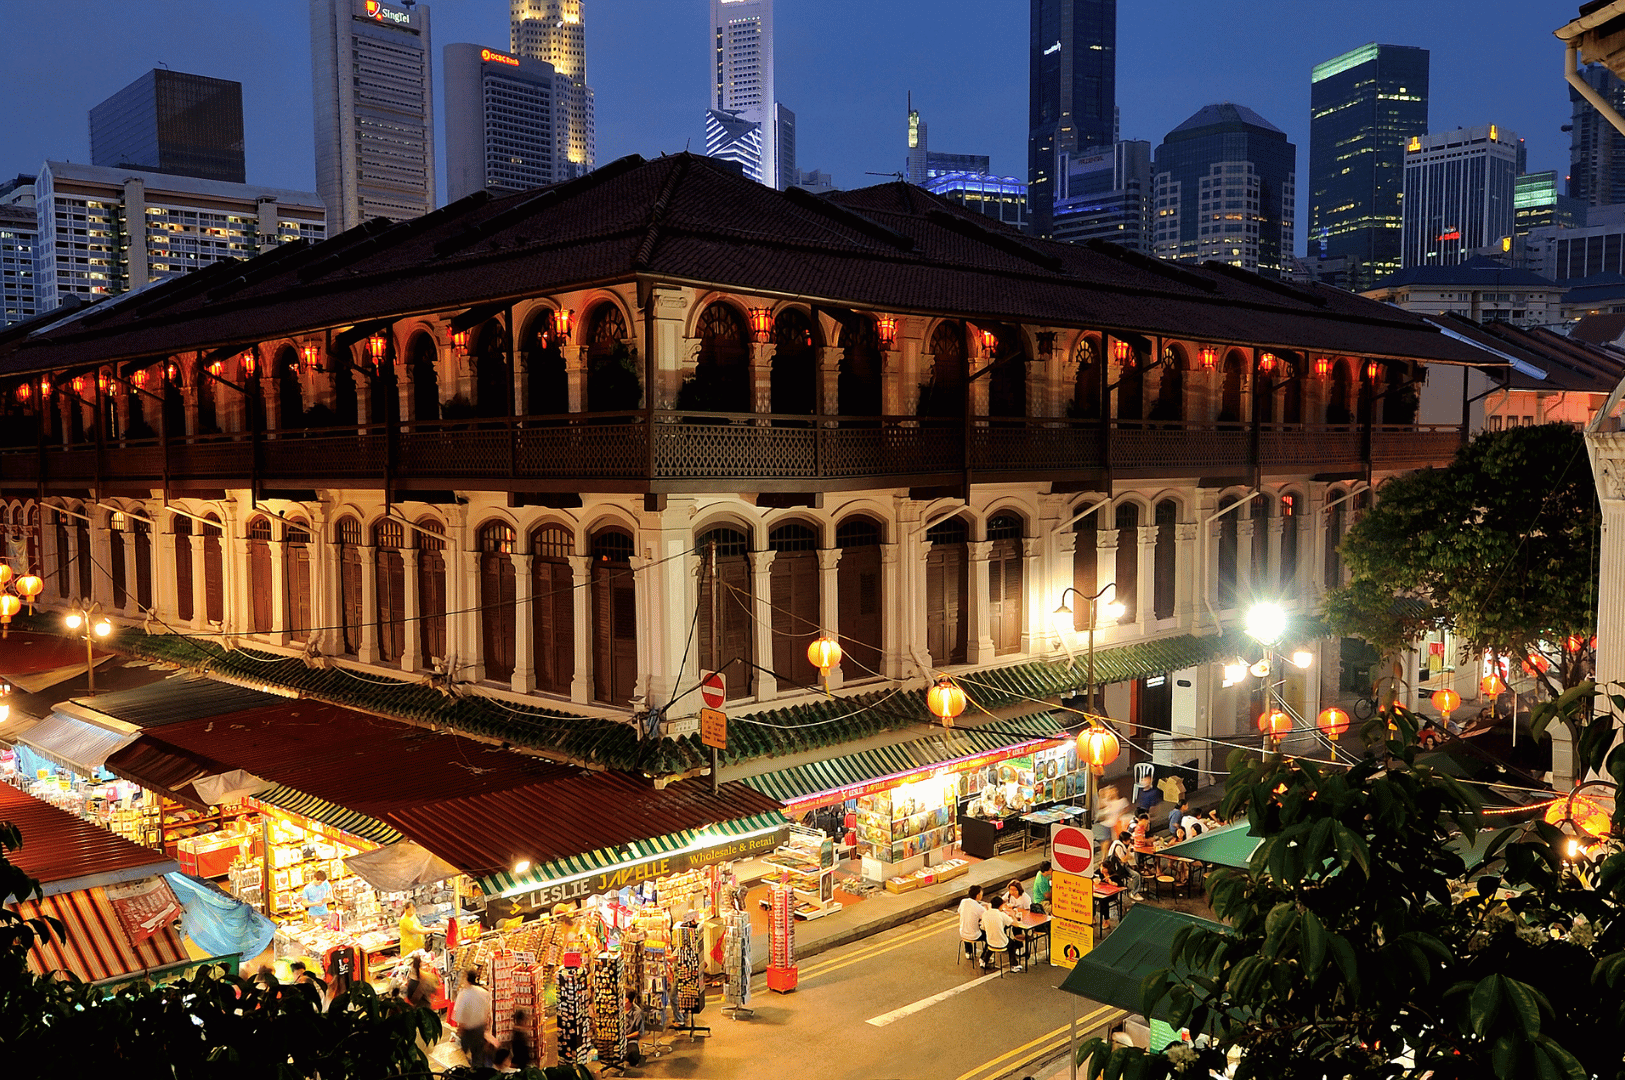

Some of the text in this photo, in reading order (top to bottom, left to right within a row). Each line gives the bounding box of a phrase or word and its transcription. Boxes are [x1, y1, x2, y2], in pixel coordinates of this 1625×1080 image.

[382, 8, 410, 23] SingTel
[530, 835, 775, 908] LESLIE JAVELLE Wholesale & Retail
[1060, 921, 1085, 932] WARNING
